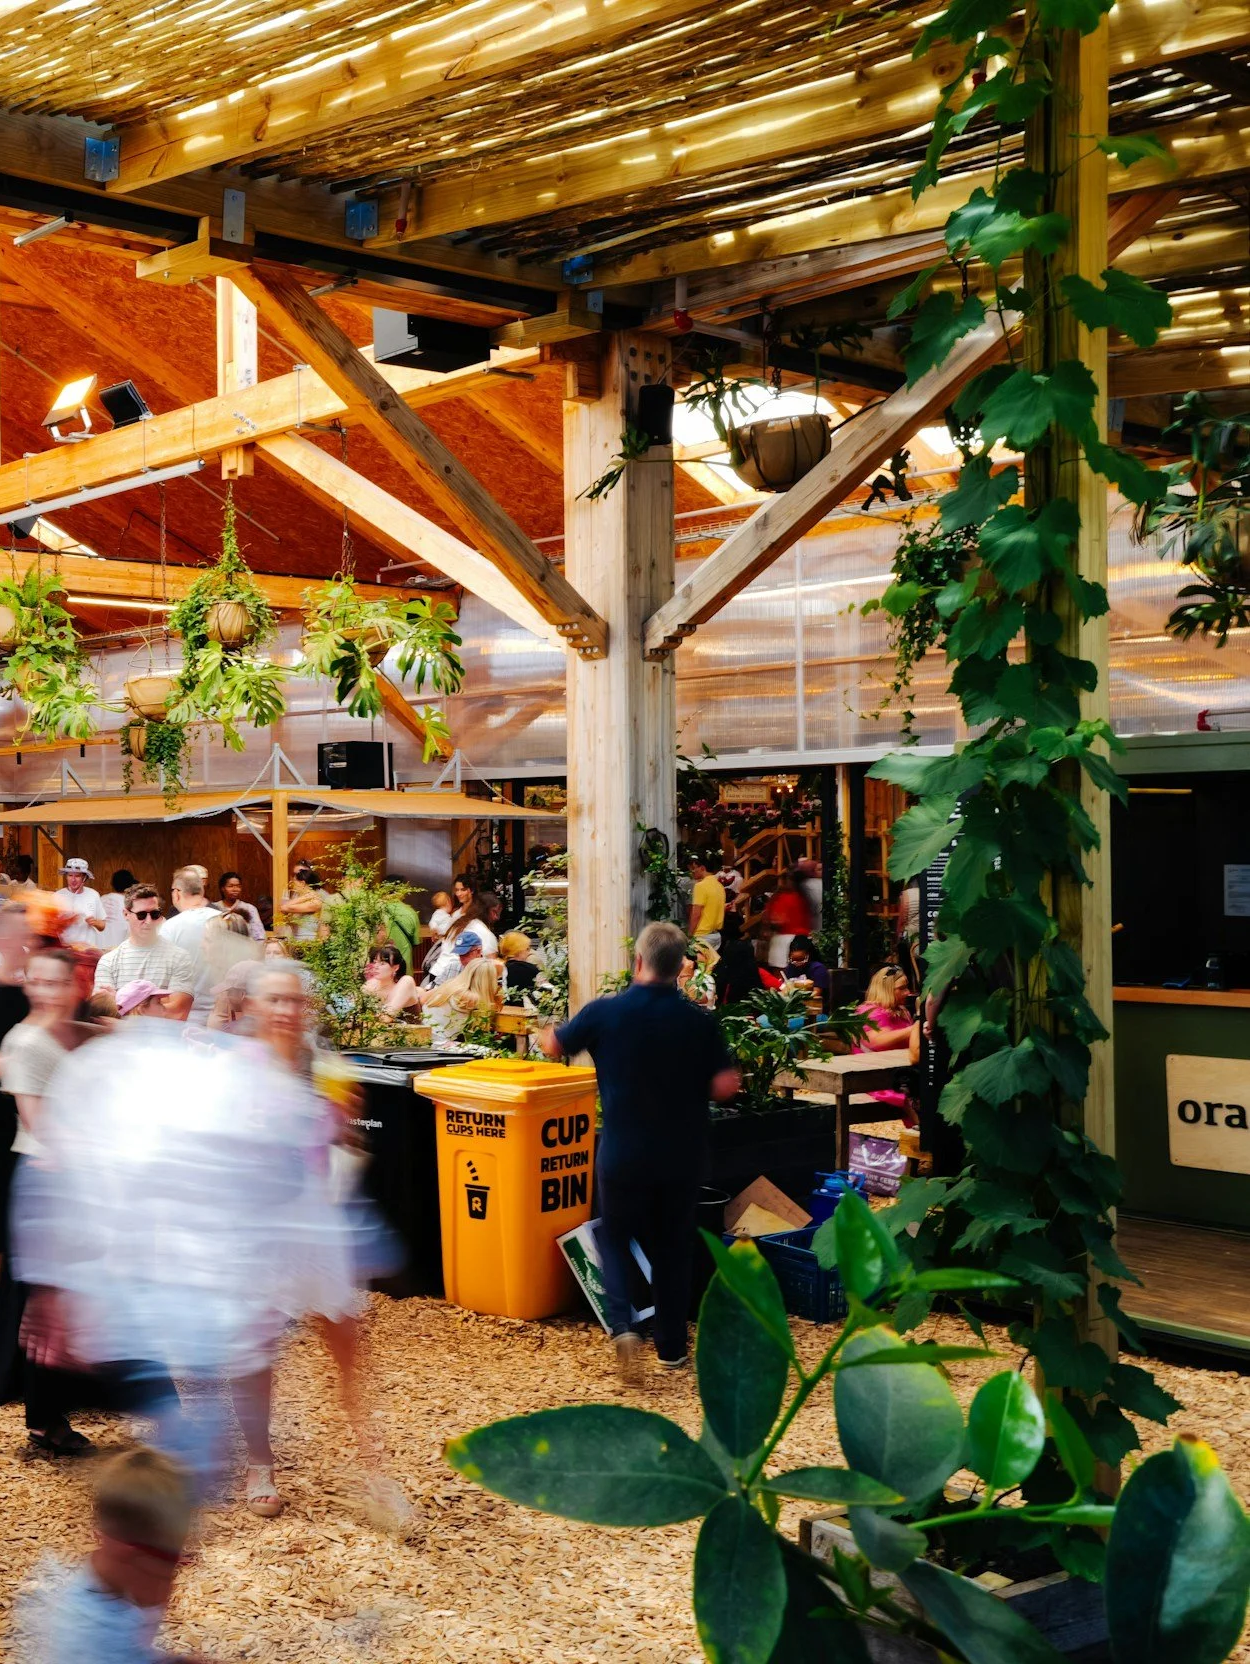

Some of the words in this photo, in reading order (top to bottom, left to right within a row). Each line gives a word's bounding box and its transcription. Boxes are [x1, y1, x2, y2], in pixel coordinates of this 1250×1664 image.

[446, 1109, 506, 1128] RETURN
[446, 1123, 474, 1136] CUPS
[476, 1126, 506, 1139] HERE
[541, 1113, 590, 1149] CUP
[540, 1150, 589, 1173] RETURN
[541, 1171, 588, 1213] BIN
